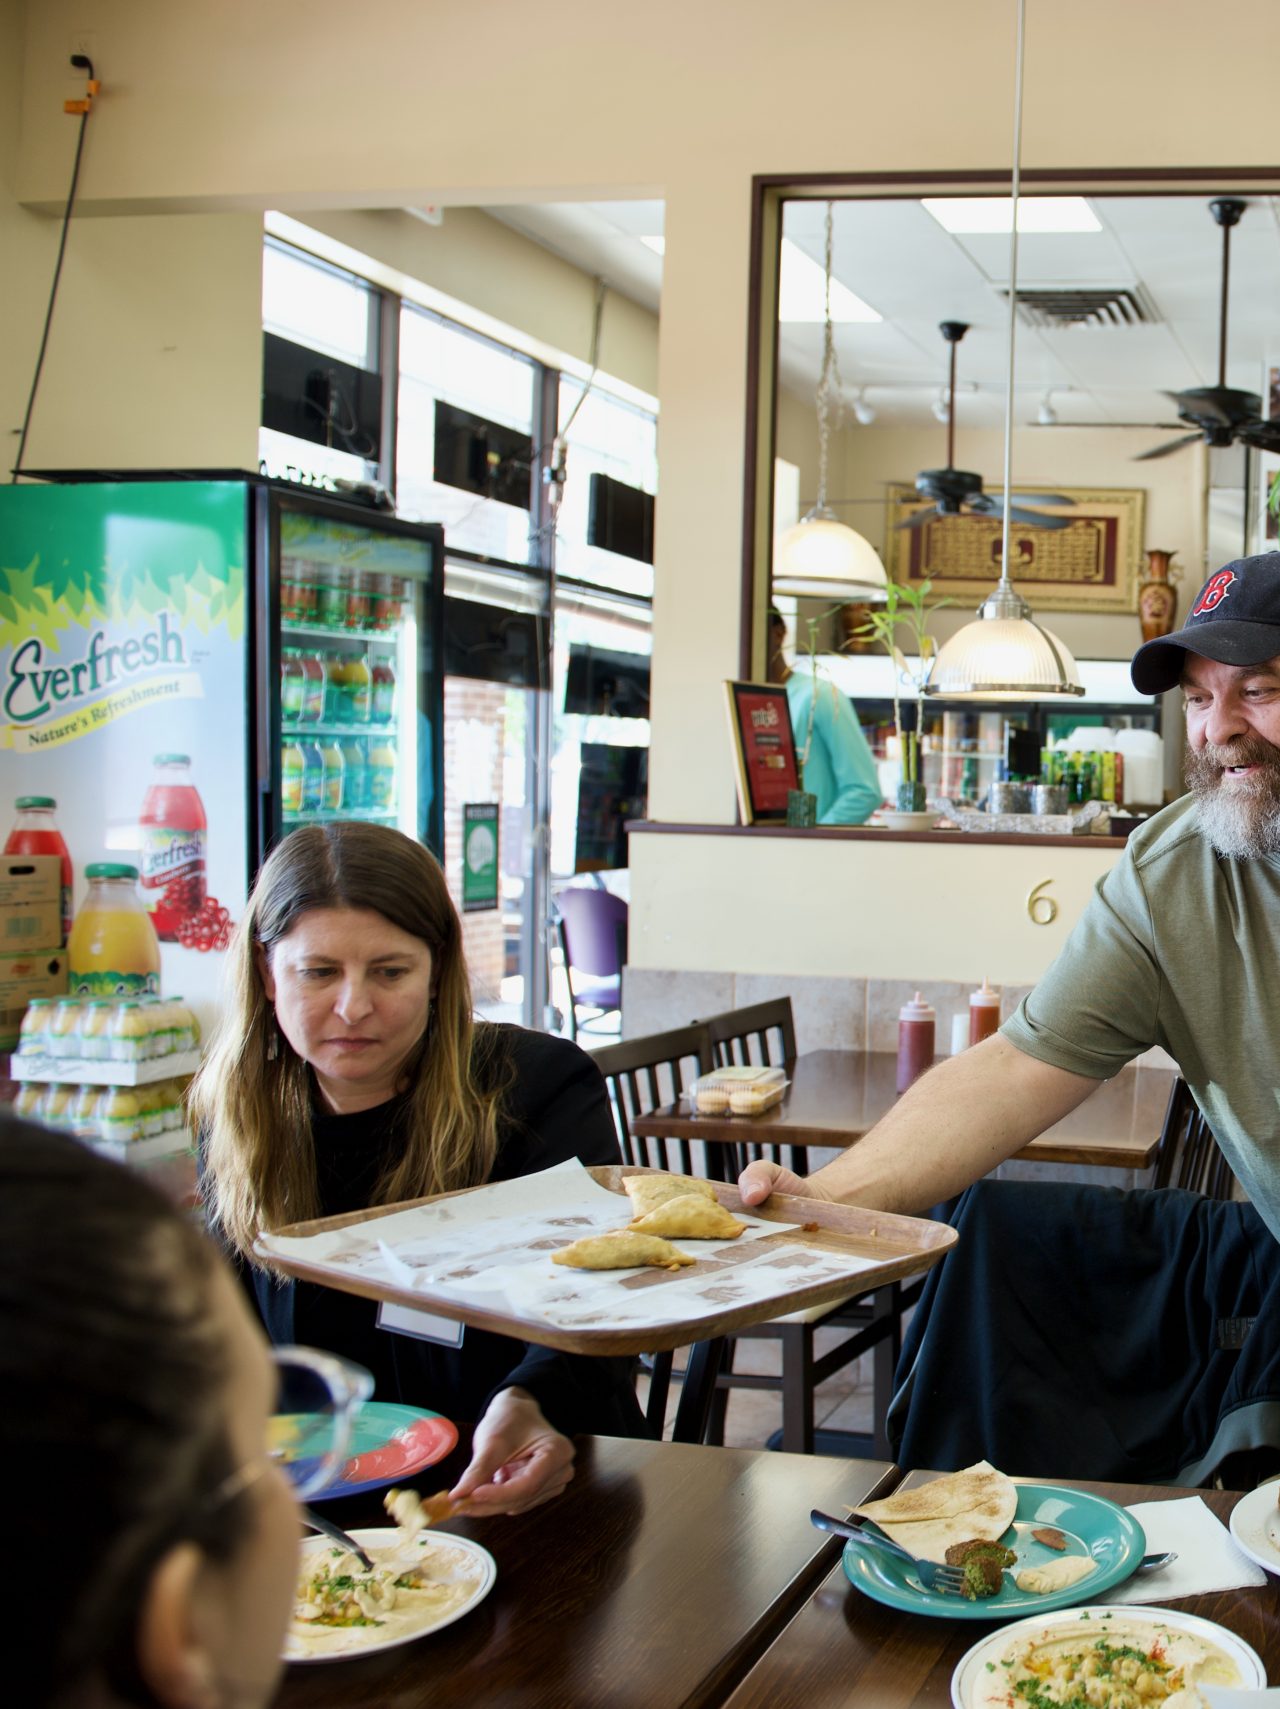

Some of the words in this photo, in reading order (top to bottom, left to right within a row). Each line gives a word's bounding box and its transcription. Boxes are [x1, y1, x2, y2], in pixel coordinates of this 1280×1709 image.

[1193, 570, 1238, 616] B
[4, 612, 186, 722] Everfresh
[28, 714, 88, 747] Nature's
[90, 680, 181, 723] Refreshment
[1028, 879, 1058, 925] 6
